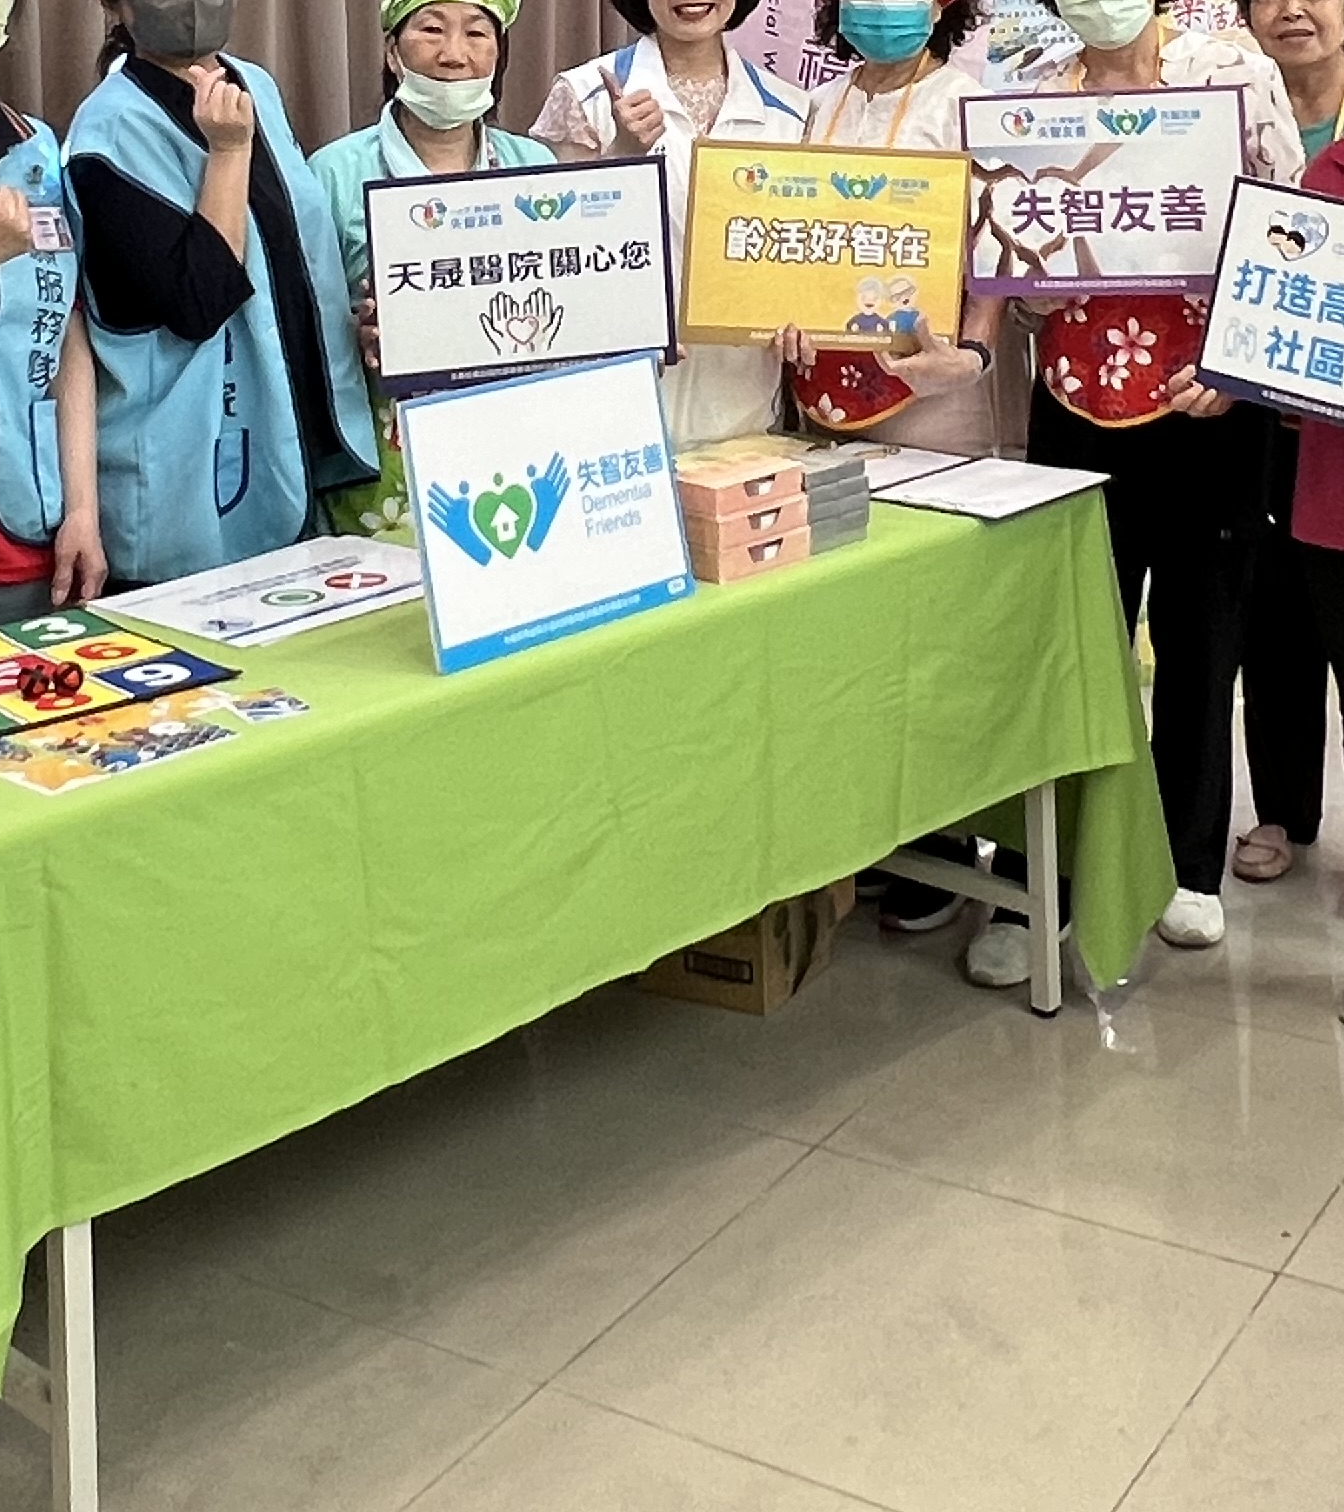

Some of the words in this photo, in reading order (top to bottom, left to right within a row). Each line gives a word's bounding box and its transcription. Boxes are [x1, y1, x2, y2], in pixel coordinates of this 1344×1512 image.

[1011, 184, 1208, 234] 失智友善
[725, 216, 931, 268] 齡活好智在
[387, 239, 652, 295] 天晟醫院關心您
[576, 441, 664, 491] 失智友善
[585, 511, 643, 538] Friends
[20, 616, 88, 642] 3
[74, 642, 139, 662] 6
[123, 662, 193, 687] 9
